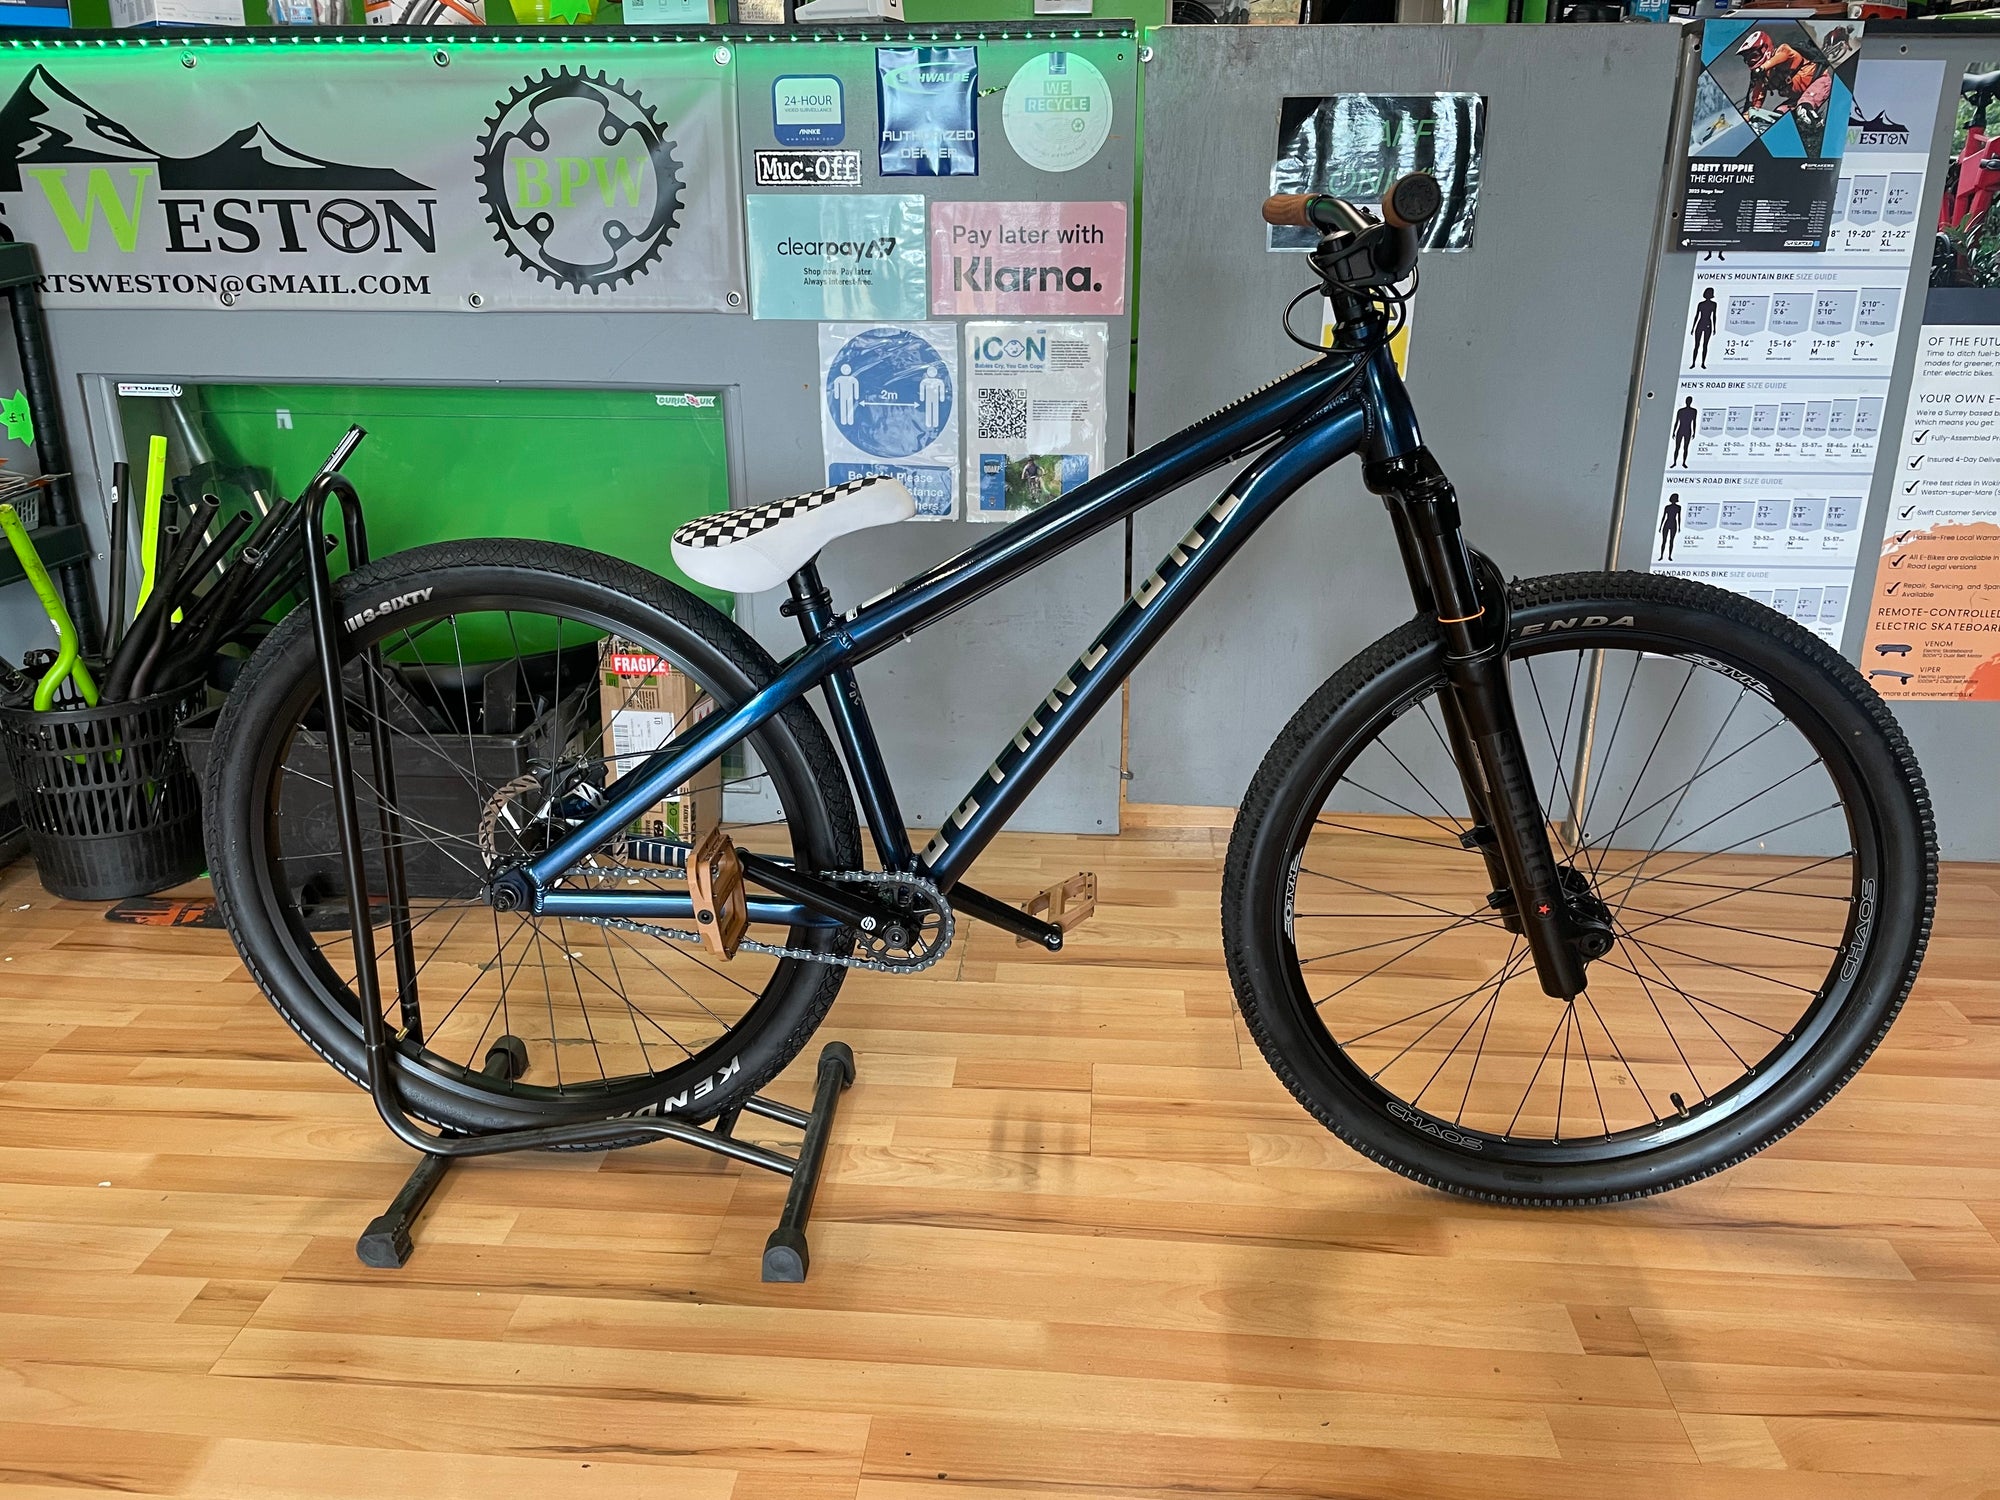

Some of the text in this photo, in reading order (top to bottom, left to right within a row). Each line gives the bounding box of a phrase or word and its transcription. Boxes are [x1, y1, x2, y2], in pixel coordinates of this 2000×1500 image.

[1045, 81, 1070, 95] WE
[784, 95, 832, 106] 24-HOUR
[1027, 98, 1089, 111] RECYCLE
[761, 155, 855, 181] Muc-Off
[1691, 163, 1755, 172] BRETT TIPPIE
[508, 156, 648, 210] BPW
[1690, 174, 1756, 184] THE RIGHT LINE
[952, 223, 1104, 249] Pay later with
[1880, 239, 1892, 247] XL
[777, 236, 865, 263] clearpay
[804, 267, 821, 277] Shop
[841, 267, 853, 276] Pay
[953, 255, 1103, 293] Klarna.
[1697, 272, 1838, 281] WOMEN'S MOUNTAIN BIKE SIZE GUIDE
[804, 278, 827, 286] Always
[1928, 336, 1945, 346] OF
[1949, 337, 1970, 346] THE
[1681, 381, 1704, 389] MEN'S
[1764, 382, 1788, 390] GUIDE
[880, 389, 898, 400] 2m
[1919, 394, 1951, 403] YOUR
[1954, 394, 1985, 403] OWN
[1944, 409, 1967, 417] Surrey
[1931, 434, 1991, 442] Fully-Assembled
[1955, 456, 1977, 464] 4-Day
[896, 472, 933, 483] Please
[1666, 477, 1702, 485] WOMEN'S
[1702, 477, 1723, 485] ROAD
[1724, 477, 1742, 485] BIKE
[1760, 478, 1783, 486] GUIDE
[907, 487, 944, 497] stance
[1921, 489, 1993, 497] Weston-super-Mare
[915, 500, 939, 510] hers
[1928, 563, 1948, 571] Legal
[1746, 571, 1770, 579] GUIDE
[1516, 614, 1635, 637] ENDA
[1875, 622, 2000, 632] ELECTRIC SKATEBOAR
[614, 656, 667, 673] FRAGILE
[1840, 878, 1876, 982] CHAOS
[606, 1055, 741, 1120] KEND
[1386, 1101, 1483, 1151] CHAOS
